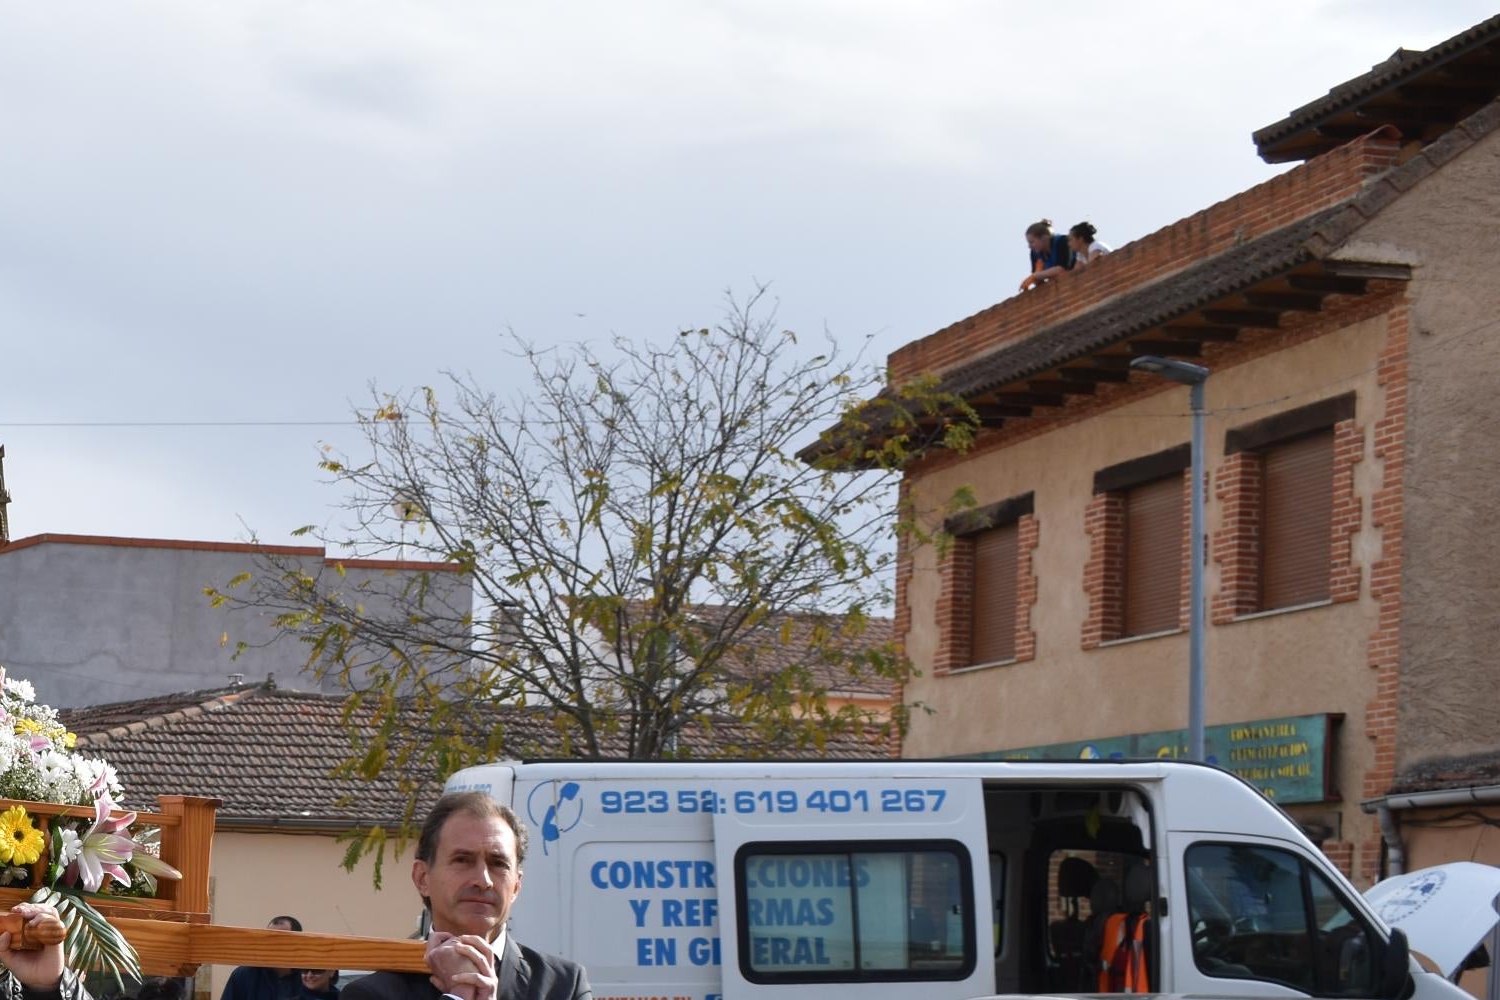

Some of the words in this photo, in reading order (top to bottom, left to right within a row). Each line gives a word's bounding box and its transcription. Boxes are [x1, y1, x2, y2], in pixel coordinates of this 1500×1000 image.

[601, 790, 669, 814] 923
[734, 790, 798, 814] 619
[806, 790, 869, 813] 401
[881, 789, 947, 813] 267
[629, 899, 650, 927] Y
[637, 938, 676, 966] EN
